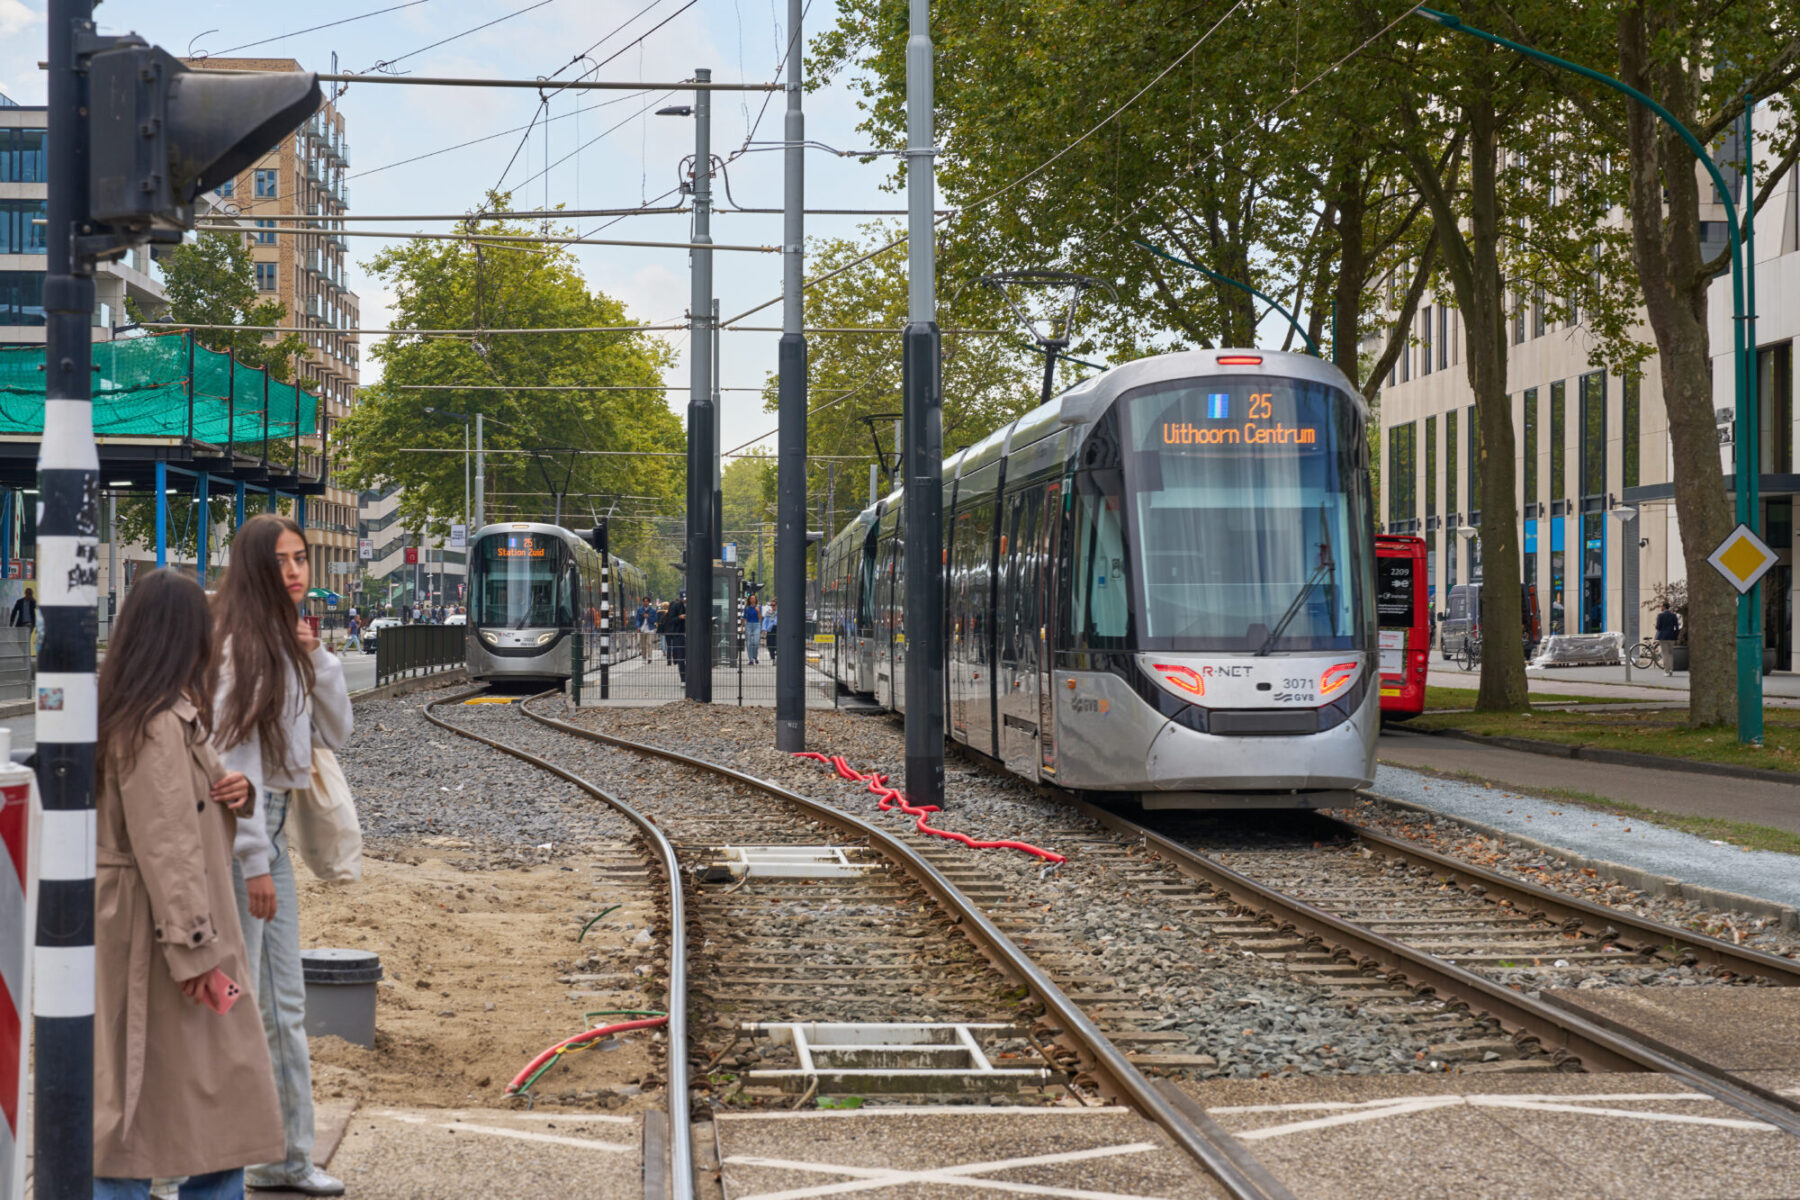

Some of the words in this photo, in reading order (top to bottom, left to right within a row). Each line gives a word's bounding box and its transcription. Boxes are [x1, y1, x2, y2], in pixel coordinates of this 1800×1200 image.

[1249, 393, 1272, 419] 25
[1163, 423, 1240, 444] Uithoorn
[1244, 423, 1316, 444] Centrum
[522, 537, 533, 548] 25
[497, 547, 526, 557] Station
[1391, 568, 1409, 576] 2209
[1283, 678, 1314, 689] 3071
[1294, 693, 1315, 702] GVB
